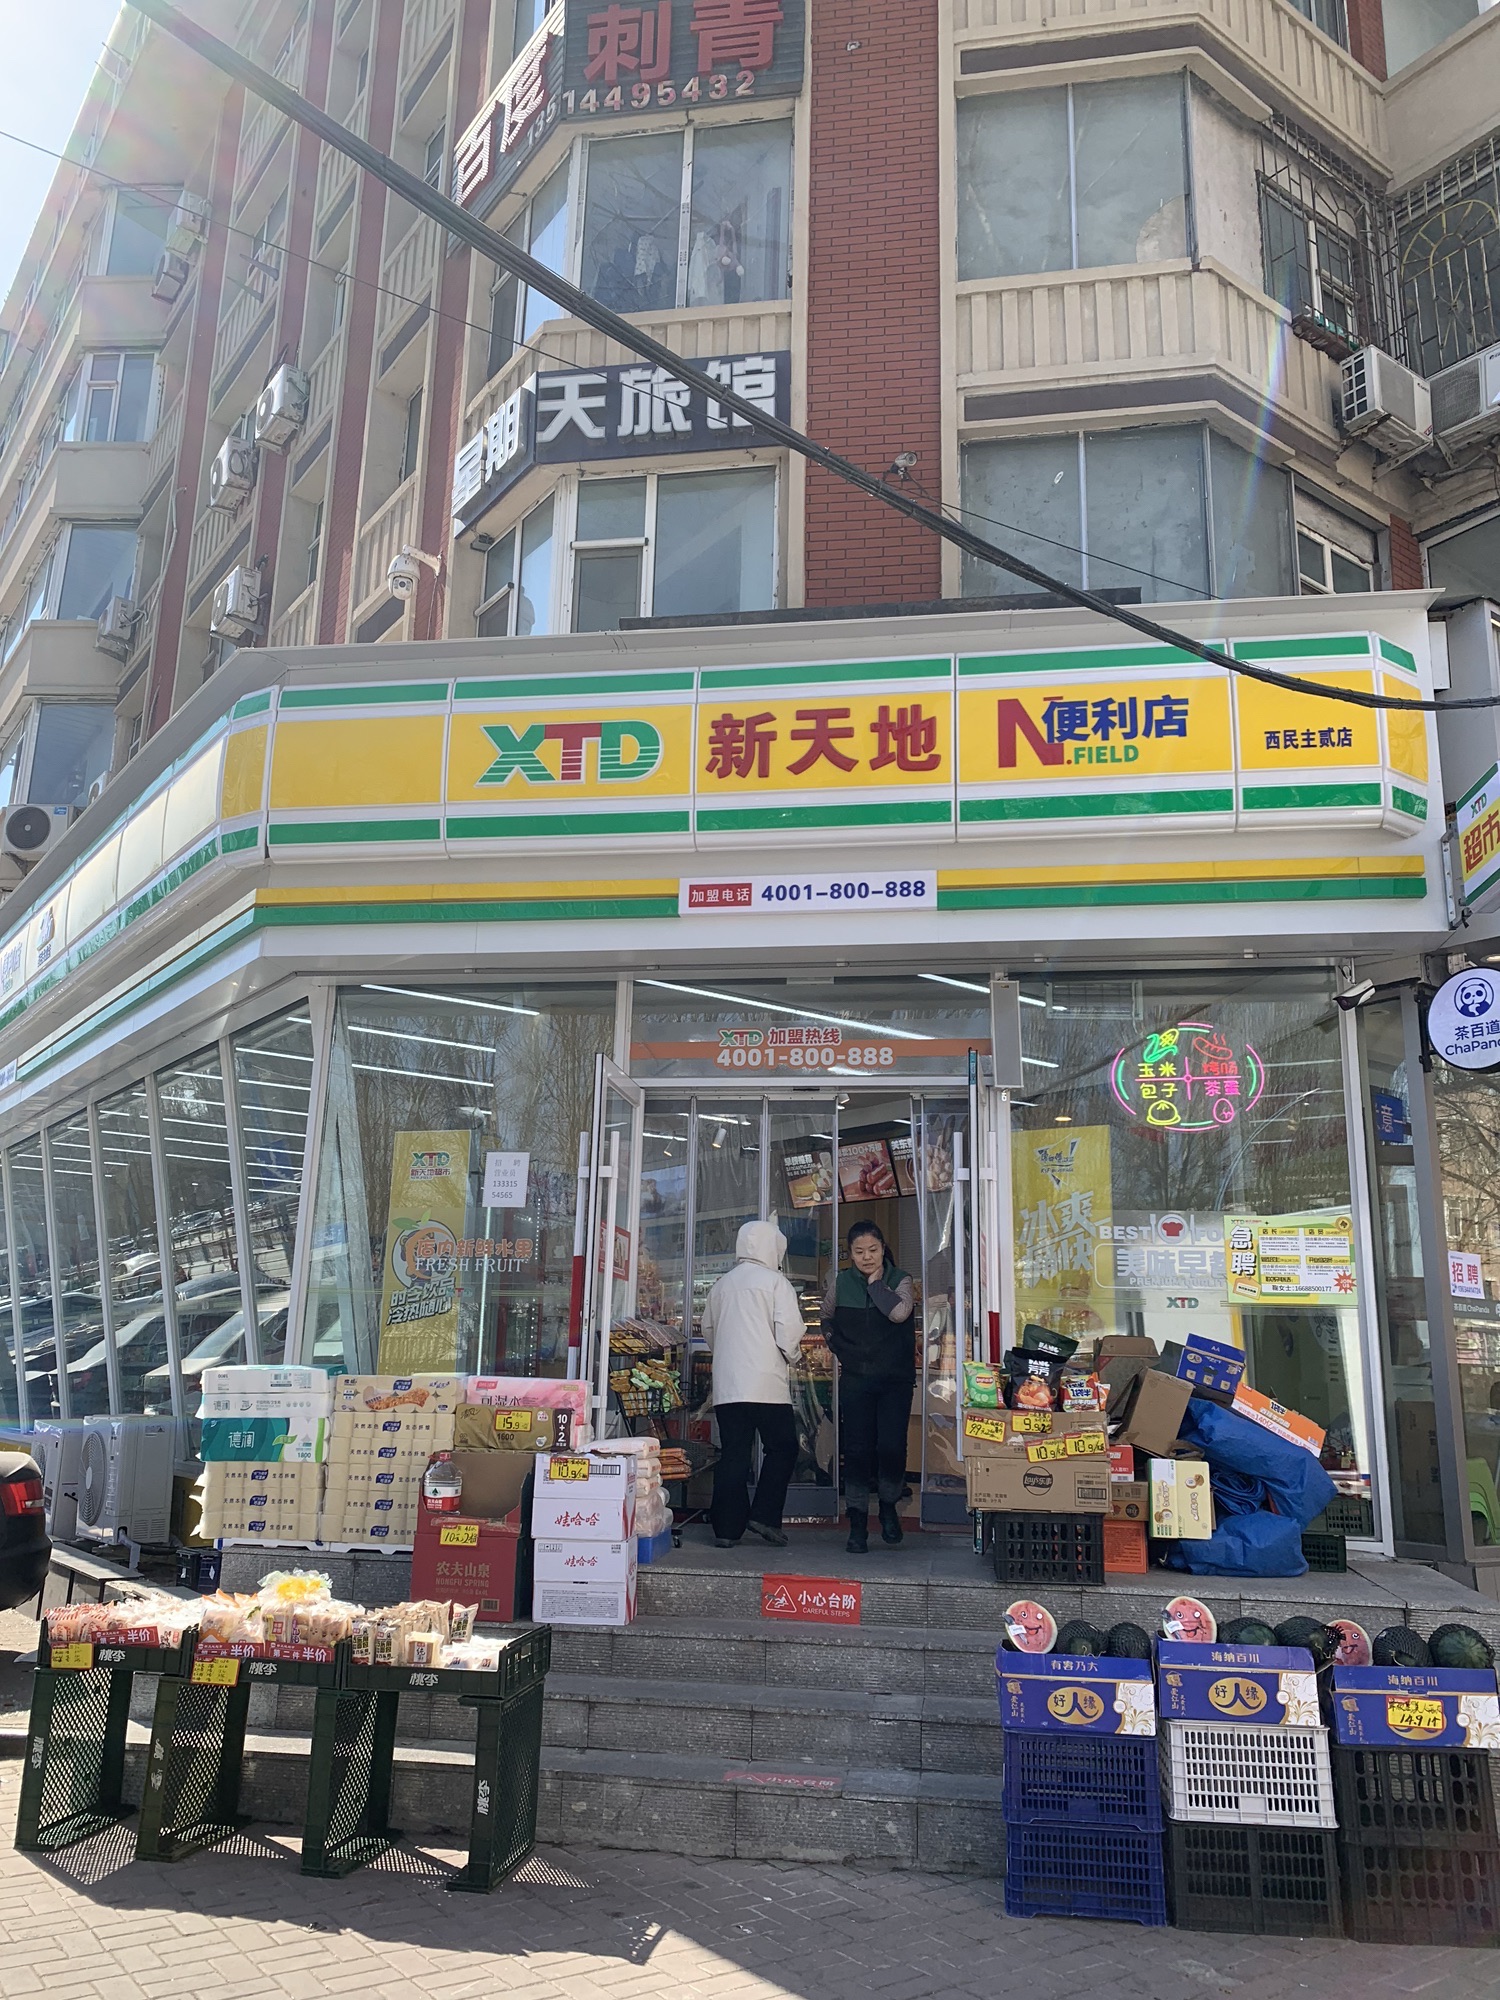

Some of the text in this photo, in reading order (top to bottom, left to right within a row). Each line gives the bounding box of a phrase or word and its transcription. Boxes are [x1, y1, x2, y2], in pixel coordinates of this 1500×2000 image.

[584, 0, 784, 85] 刺青
[537, 356, 777, 443] 天旅馆
[1042, 695, 1189, 743] 便利店
[706, 704, 942, 779] 新天地
[1265, 727, 1354, 751] 西民主贰店
[474, 720, 664, 787] XTD
[1471, 792, 1488, 818] XTD
[1464, 809, 1500, 874] 超市
[690, 887, 751, 904] 加盟电话
[761, 880, 926, 902] 4001-800-888
[719, 1030, 762, 1046] XTD
[768, 1028, 842, 1045] 加盟热线
[1455, 1018, 1500, 1041] 茶百道
[717, 1046, 894, 1067] 4001-800-888
[1138, 1061, 1177, 1078] 玉米
[1140, 1082, 1178, 1099] 包子
[1204, 1080, 1241, 1096] 茶蛋
[411, 1152, 451, 1167] XTD
[493, 1180, 518, 1188] 133315
[1019, 1191, 1111, 1245] 冰爽
[1099, 1225, 1151, 1240] BEST
[418, 1238, 533, 1258] 店内新鲜水果
[1230, 1226, 1256, 1276] 急聘
[415, 1258, 524, 1273] FRESH FRUIT
[1452, 1262, 1478, 1285] 招聘
[391, 1276, 456, 1307] 时令饮品
[1183, 1279, 1225, 1288] QUALIT
[1167, 1297, 1199, 1308] XTD
[555, 1511, 600, 1527] 娃哈哈
[436, 1561, 490, 1578] 农夫山泉
[436, 1578, 489, 1588] NONGFU SPRING
[797, 1590, 857, 1610] 小心台阶
[802, 1607, 850, 1618] CAREFUL STEPS
[127, 1630, 151, 1643] 半价
[99, 1648, 126, 1662] 桃李
[302, 1647, 327, 1663] 半价
[1211, 1651, 1260, 1664] 海纳百川
[249, 1662, 278, 1676] 桃李
[409, 1672, 439, 1687] 桃李
[1387, 1674, 1438, 1686] 海纳百川
[1053, 1691, 1099, 1718] 好人缘
[1214, 1682, 1262, 1710] 好人缘
[476, 1779, 491, 1816] 桃李
